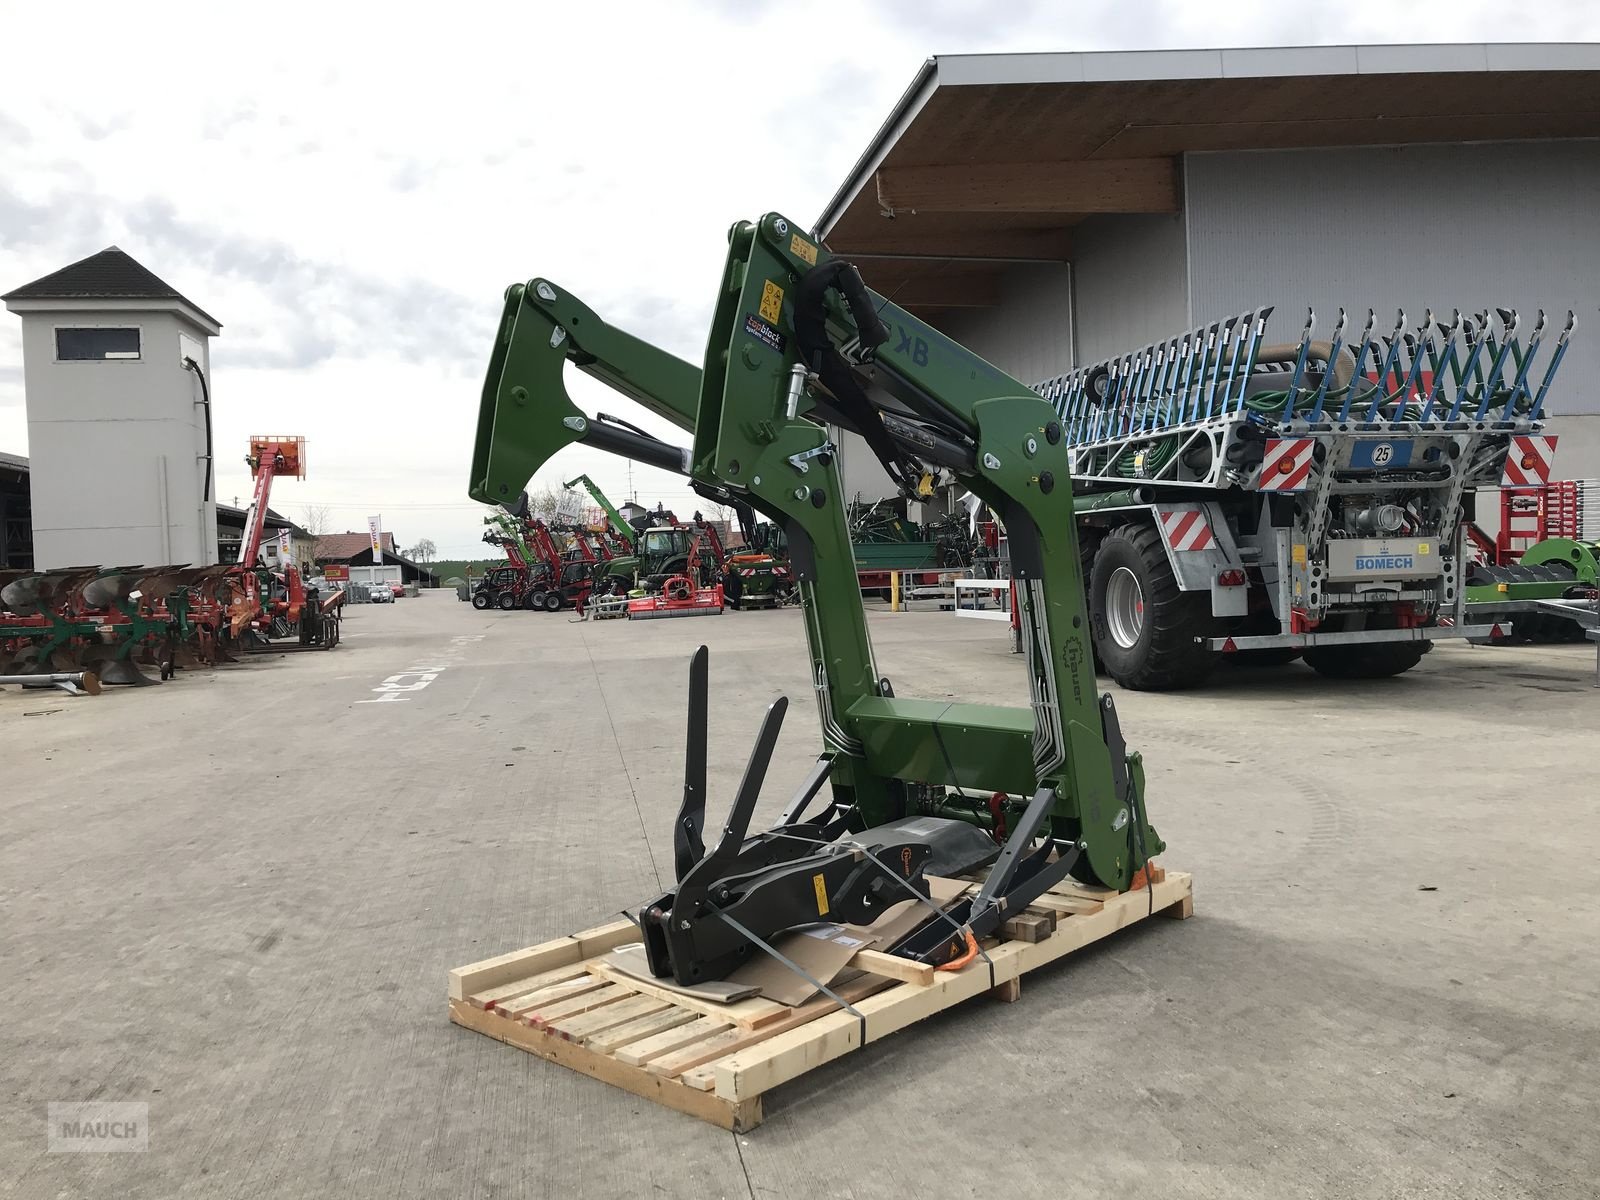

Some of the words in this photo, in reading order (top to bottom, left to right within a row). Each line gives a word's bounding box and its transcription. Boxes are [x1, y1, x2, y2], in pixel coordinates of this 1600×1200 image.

[747, 315, 781, 343] topblock
[1374, 446, 1391, 462] 25
[1355, 557, 1413, 571] BOMECH
[1068, 647, 1083, 706] hauer
